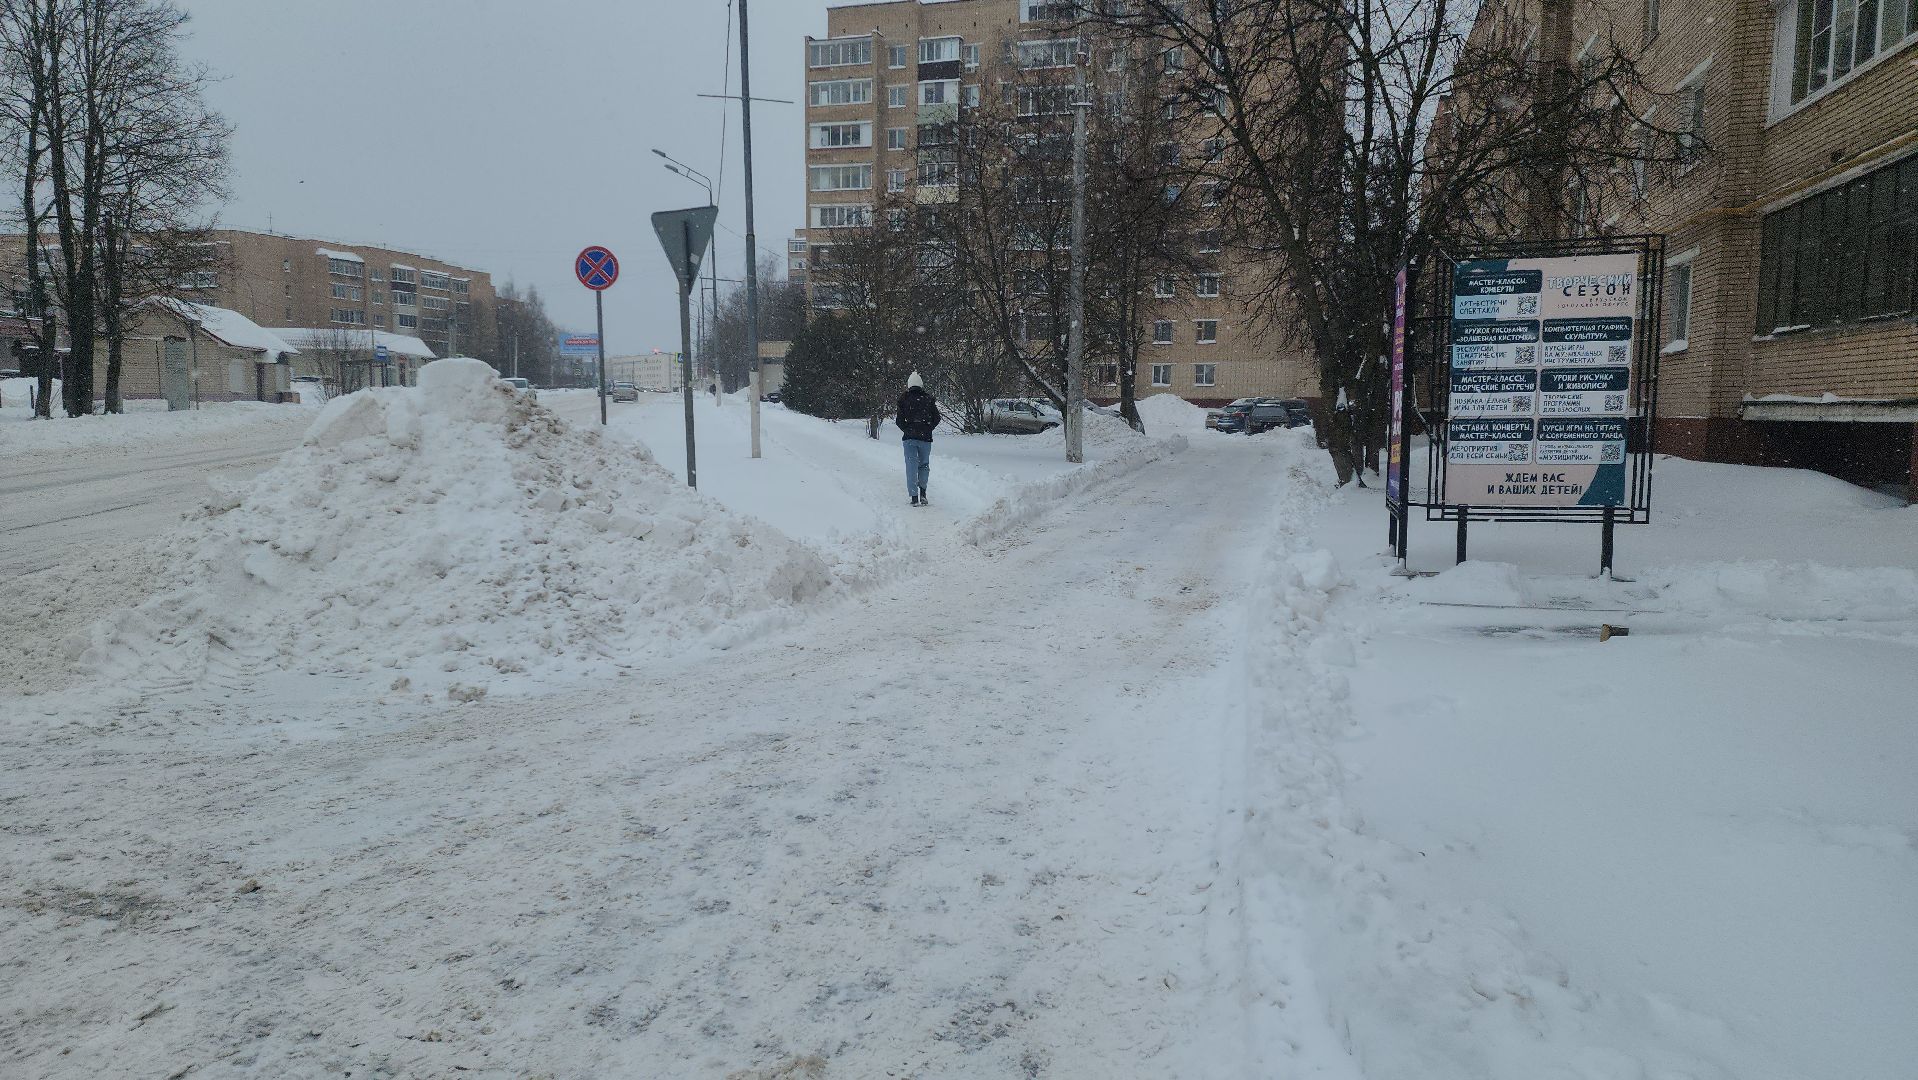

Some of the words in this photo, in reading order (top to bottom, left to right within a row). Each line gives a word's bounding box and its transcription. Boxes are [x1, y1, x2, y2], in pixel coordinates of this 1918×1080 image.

[1547, 272, 1632, 289] ТВОРЧЕСКИЙ
[1480, 286, 1515, 294] КОНЦЕРТЫ
[1562, 284, 1630, 296] СЕЗОН
[1461, 375, 1526, 383] МАСТЕР-КЛАССЫ,
[1504, 472, 1538, 483] ЖДЕМ
[1542, 473, 1566, 482] ВАС
[1487, 484, 1494, 494] И
[1498, 484, 1536, 494] ВАШИХ
[1541, 484, 1582, 494] ДЕТЕЙ!
